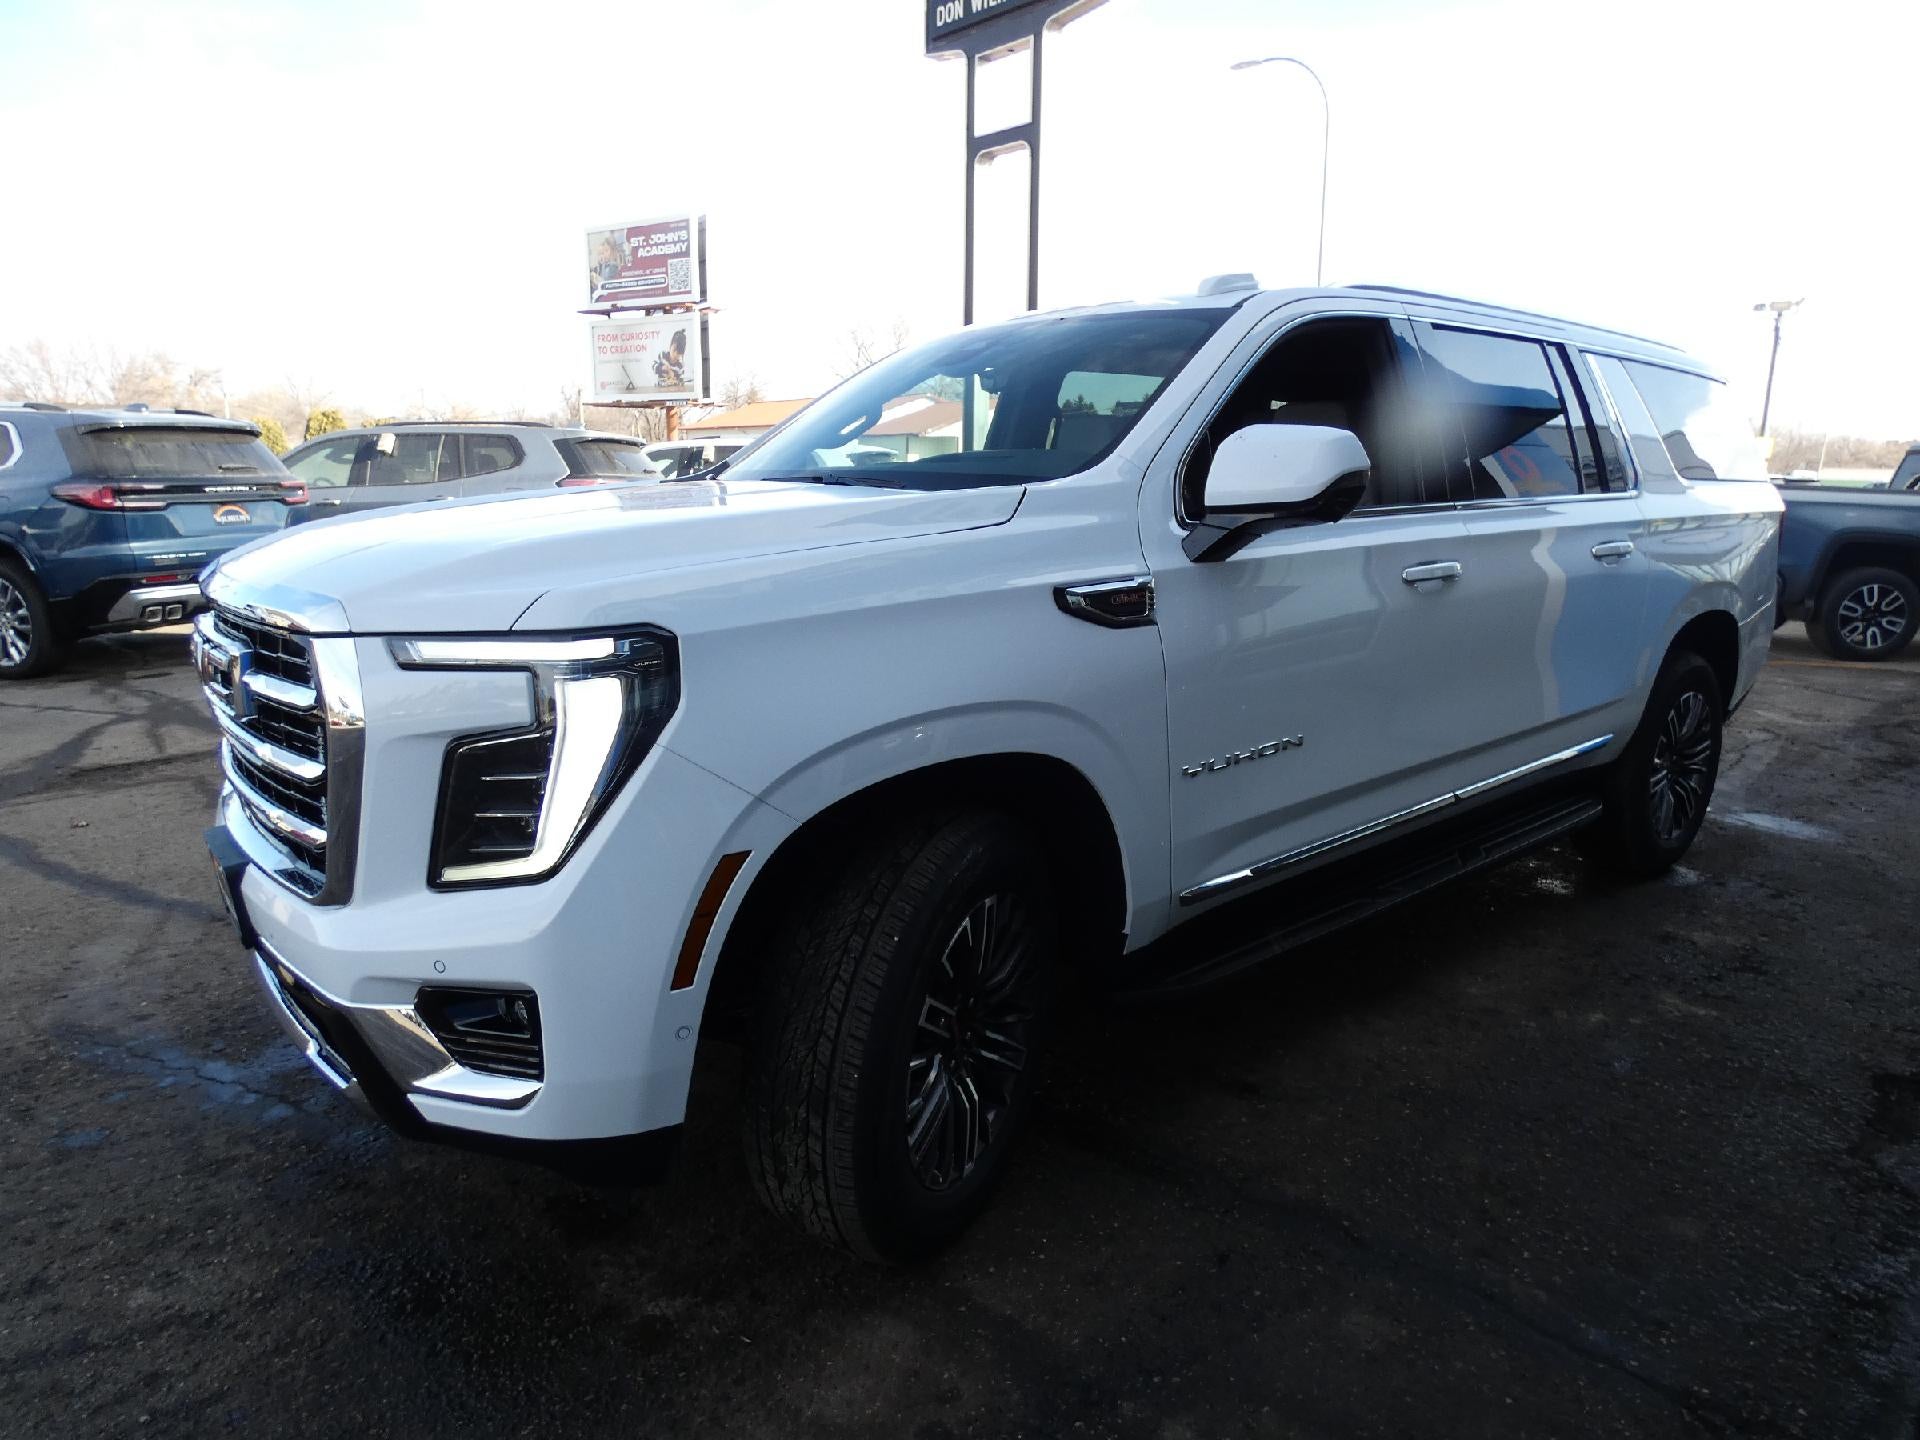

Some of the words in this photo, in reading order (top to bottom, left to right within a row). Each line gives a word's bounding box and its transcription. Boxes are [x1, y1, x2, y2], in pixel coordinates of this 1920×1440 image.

[937, 0, 963, 26] DON
[631, 236, 646, 247] ST.
[649, 231, 688, 244] JOHN'S
[638, 242, 688, 257] ACADEMY
[597, 333, 619, 342] FROM
[620, 331, 660, 341] CURIOSITY
[598, 346, 607, 354] TO
[610, 344, 647, 354] CREATION
[1182, 734, 1303, 777] YUKON
